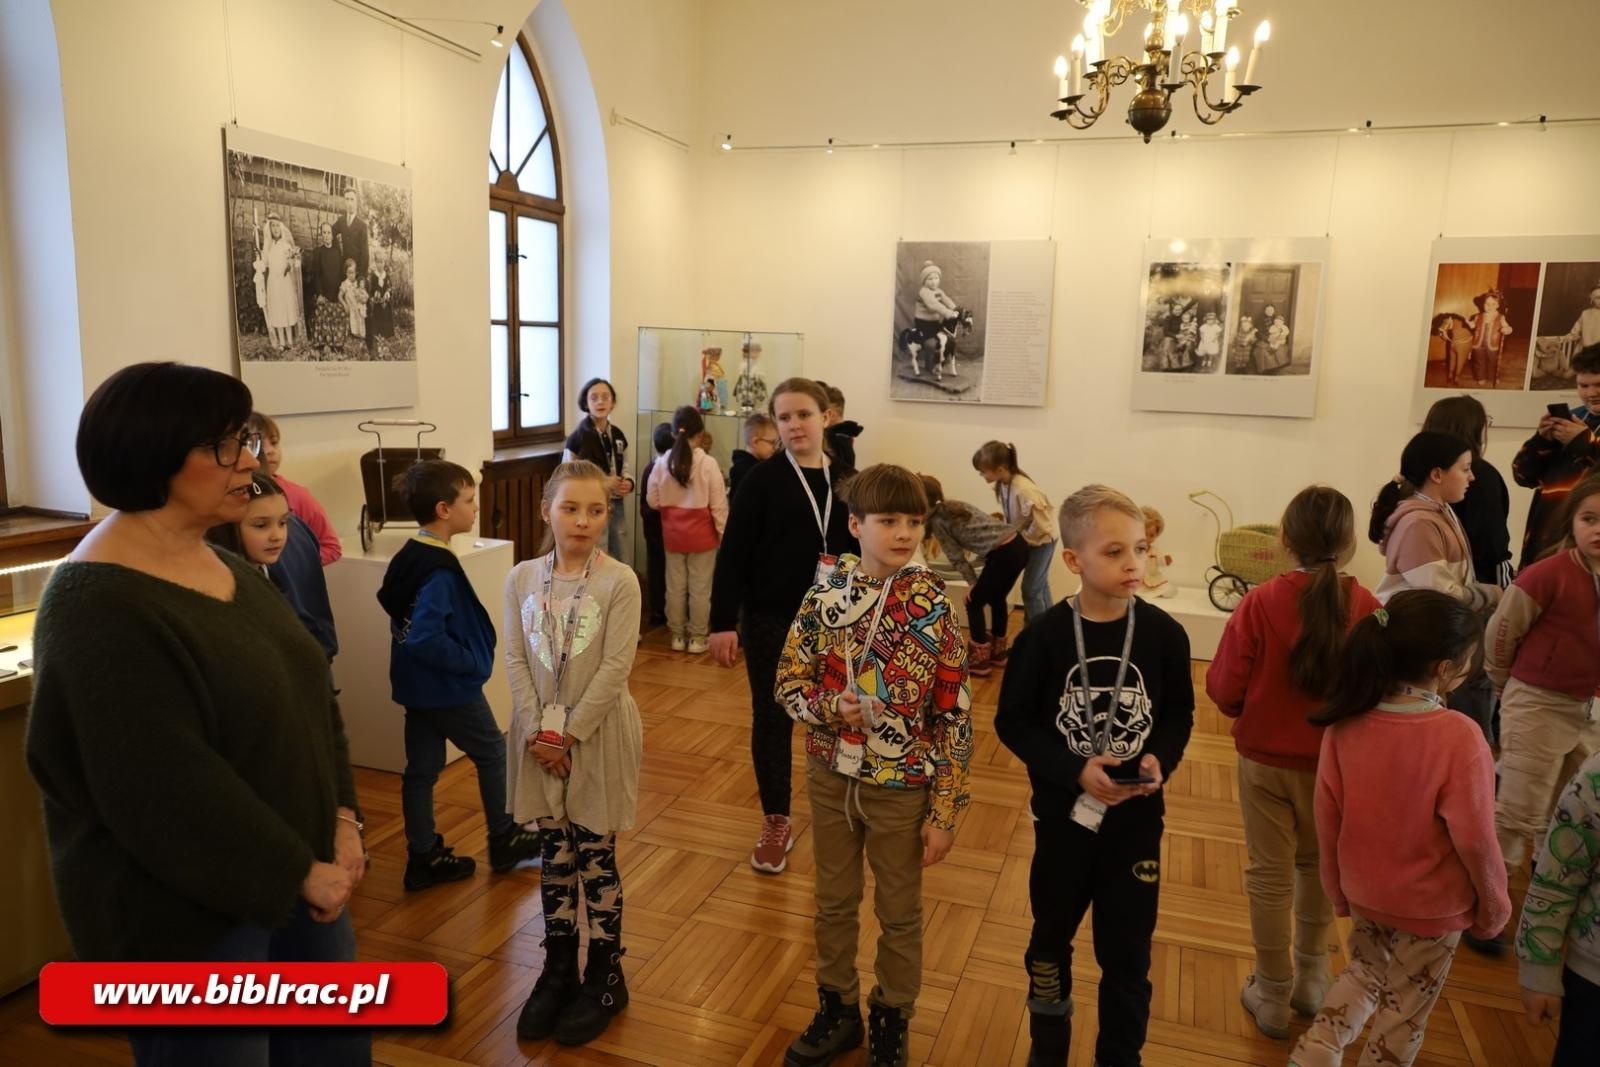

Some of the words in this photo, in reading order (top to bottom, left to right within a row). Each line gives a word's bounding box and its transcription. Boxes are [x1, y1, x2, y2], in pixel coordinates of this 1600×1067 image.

[826, 586, 868, 625] BUR
[530, 611, 589, 638] LOVE
[893, 651, 932, 685] SNAX
